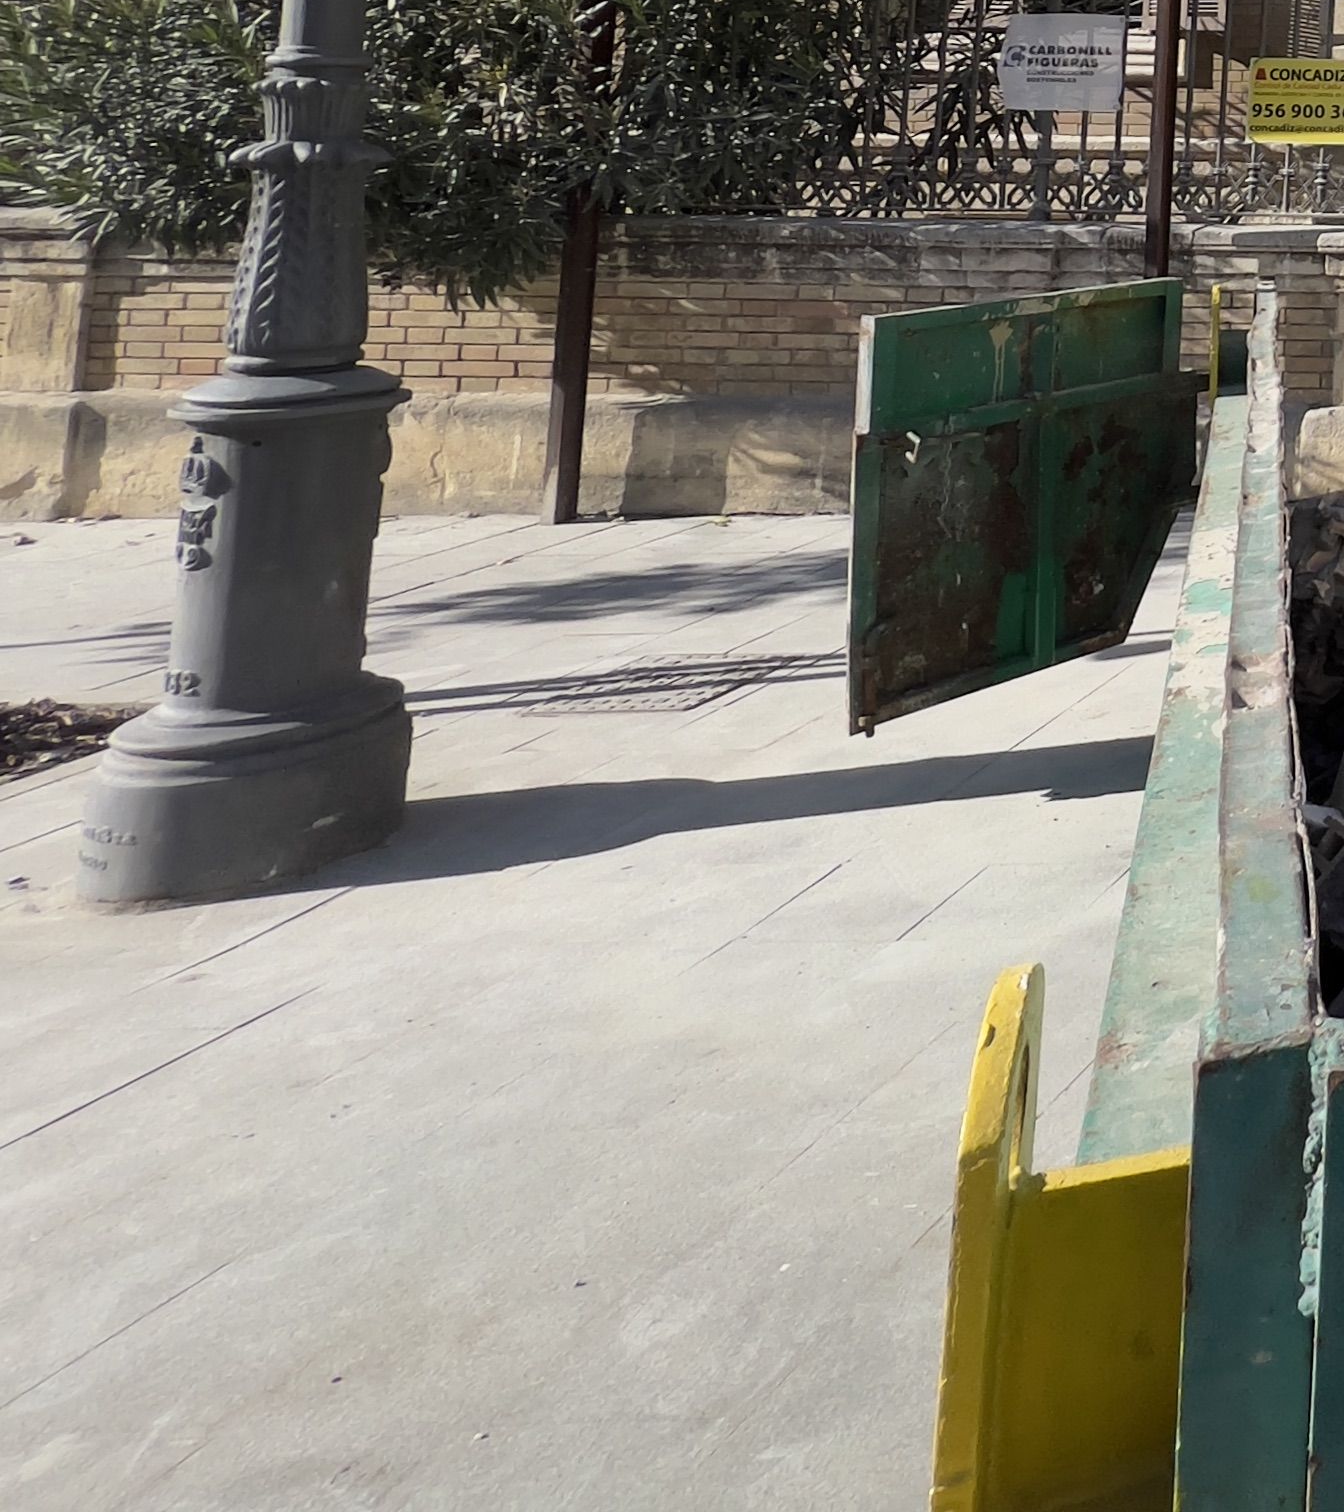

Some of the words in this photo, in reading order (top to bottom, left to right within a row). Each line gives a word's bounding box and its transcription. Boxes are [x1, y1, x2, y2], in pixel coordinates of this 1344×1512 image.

[1028, 45, 1112, 55] CARBONELL
[1027, 57, 1099, 68] FIGUERAS
[1252, 103, 1286, 118] 956
[1291, 104, 1325, 119] 900
